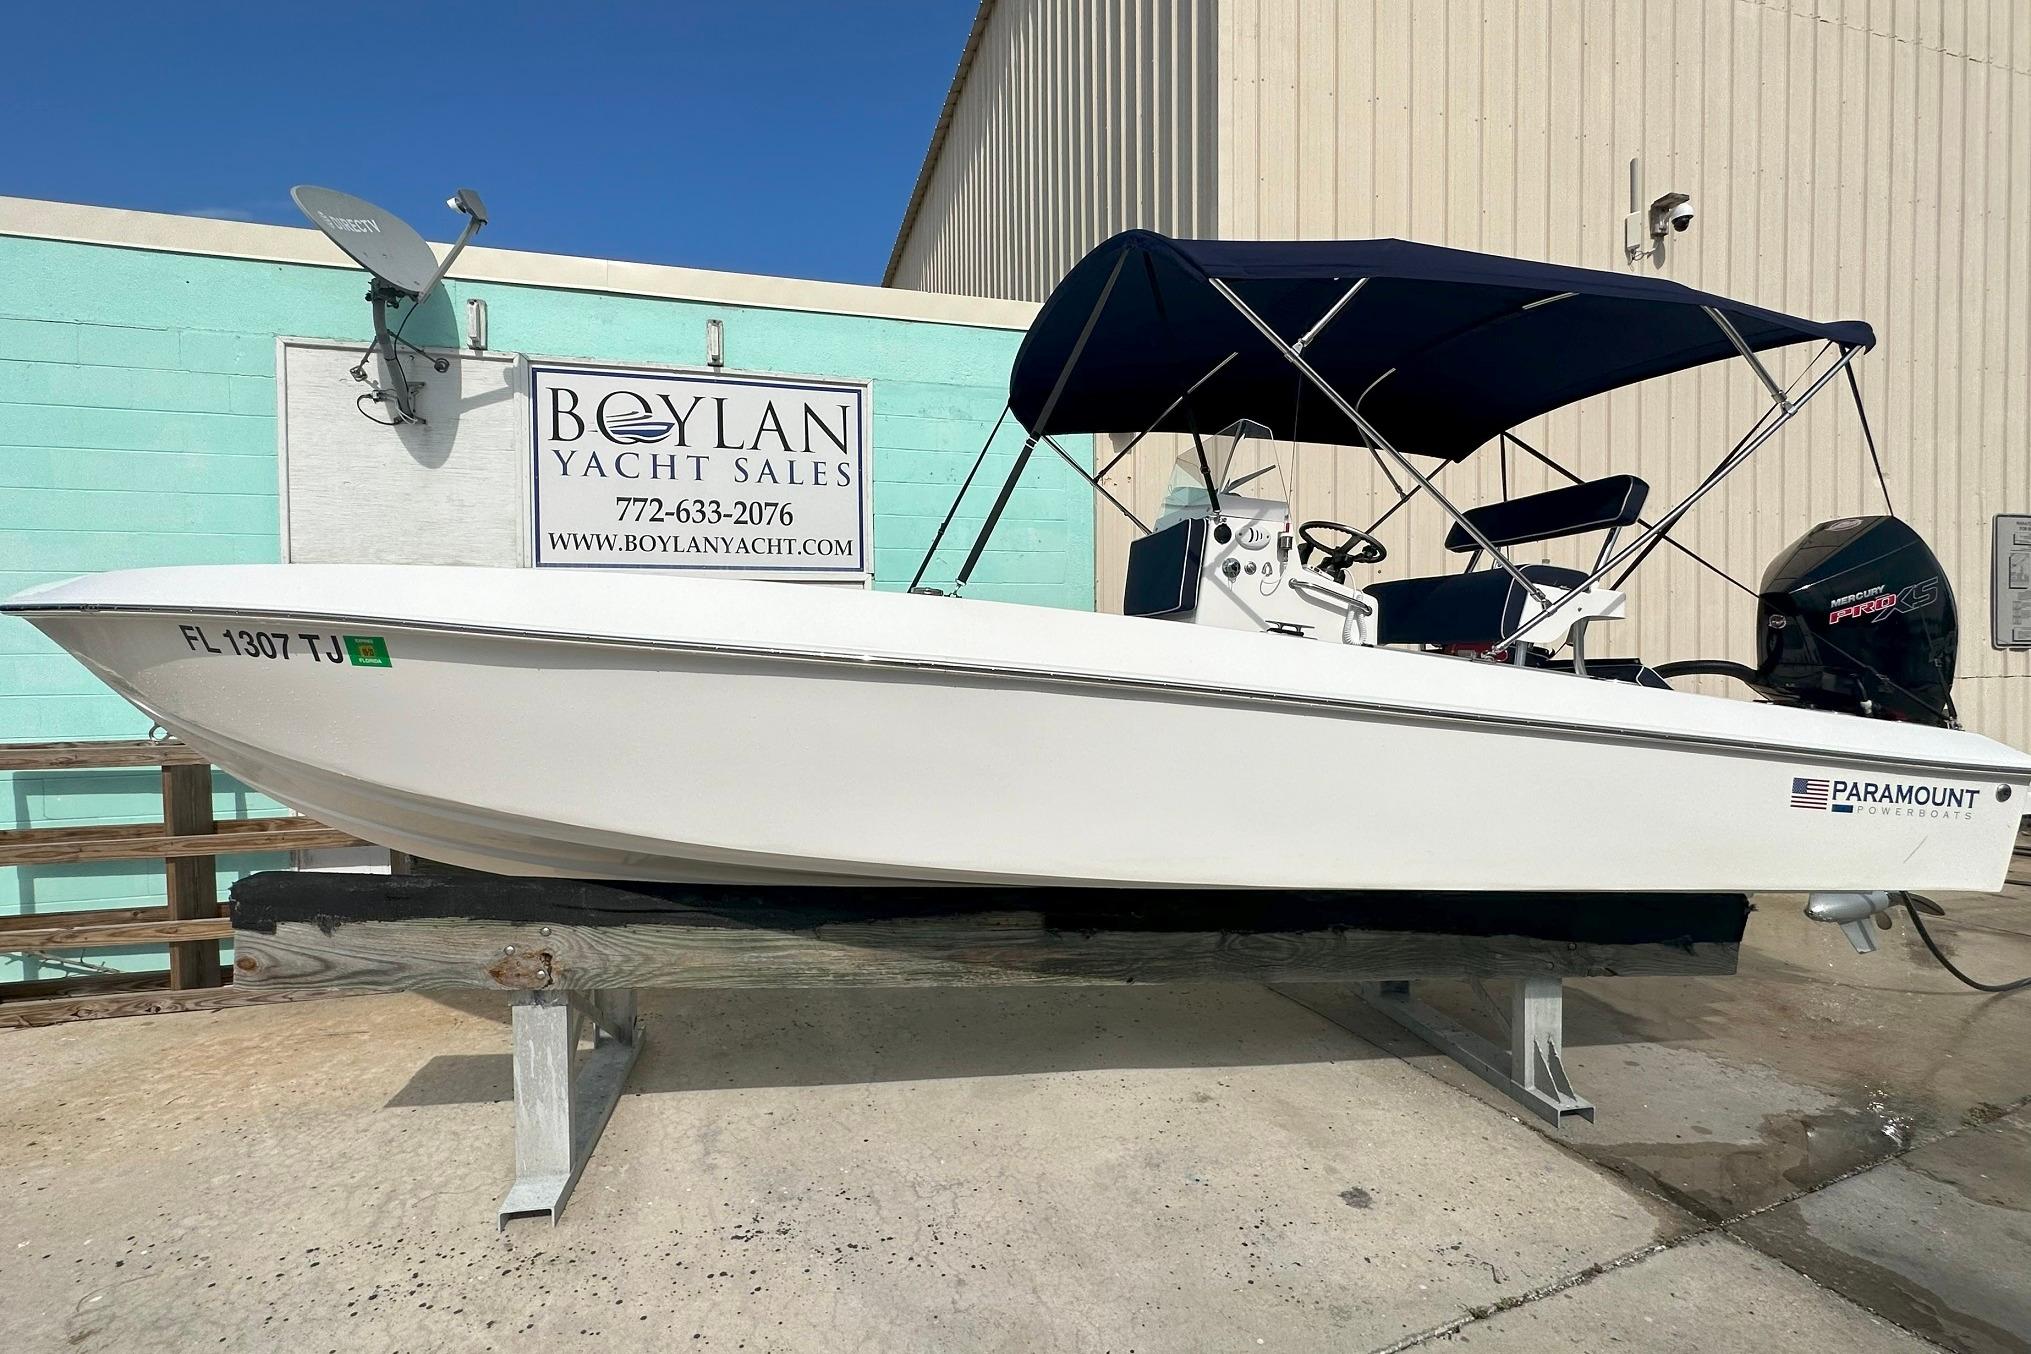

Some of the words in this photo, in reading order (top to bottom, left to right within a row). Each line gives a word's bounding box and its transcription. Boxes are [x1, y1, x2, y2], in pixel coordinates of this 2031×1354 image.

[328, 215, 381, 233] DIRECTV
[546, 386, 851, 455] BOYLAN
[552, 449, 710, 481] YACHT
[734, 457, 851, 487] SALES
[616, 496, 794, 526] 772-633-2076
[548, 532, 853, 557] WWW.BOYLANYACHT.COM
[1829, 593, 1897, 625] PRO
[1830, 584, 1886, 609] MERCURY
[178, 624, 222, 654] FL
[223, 629, 290, 660] 1307
[298, 633, 345, 664] TJ
[1832, 779, 1981, 809] PARAMOUNT
[1857, 804, 1973, 820] POWERBOATS
